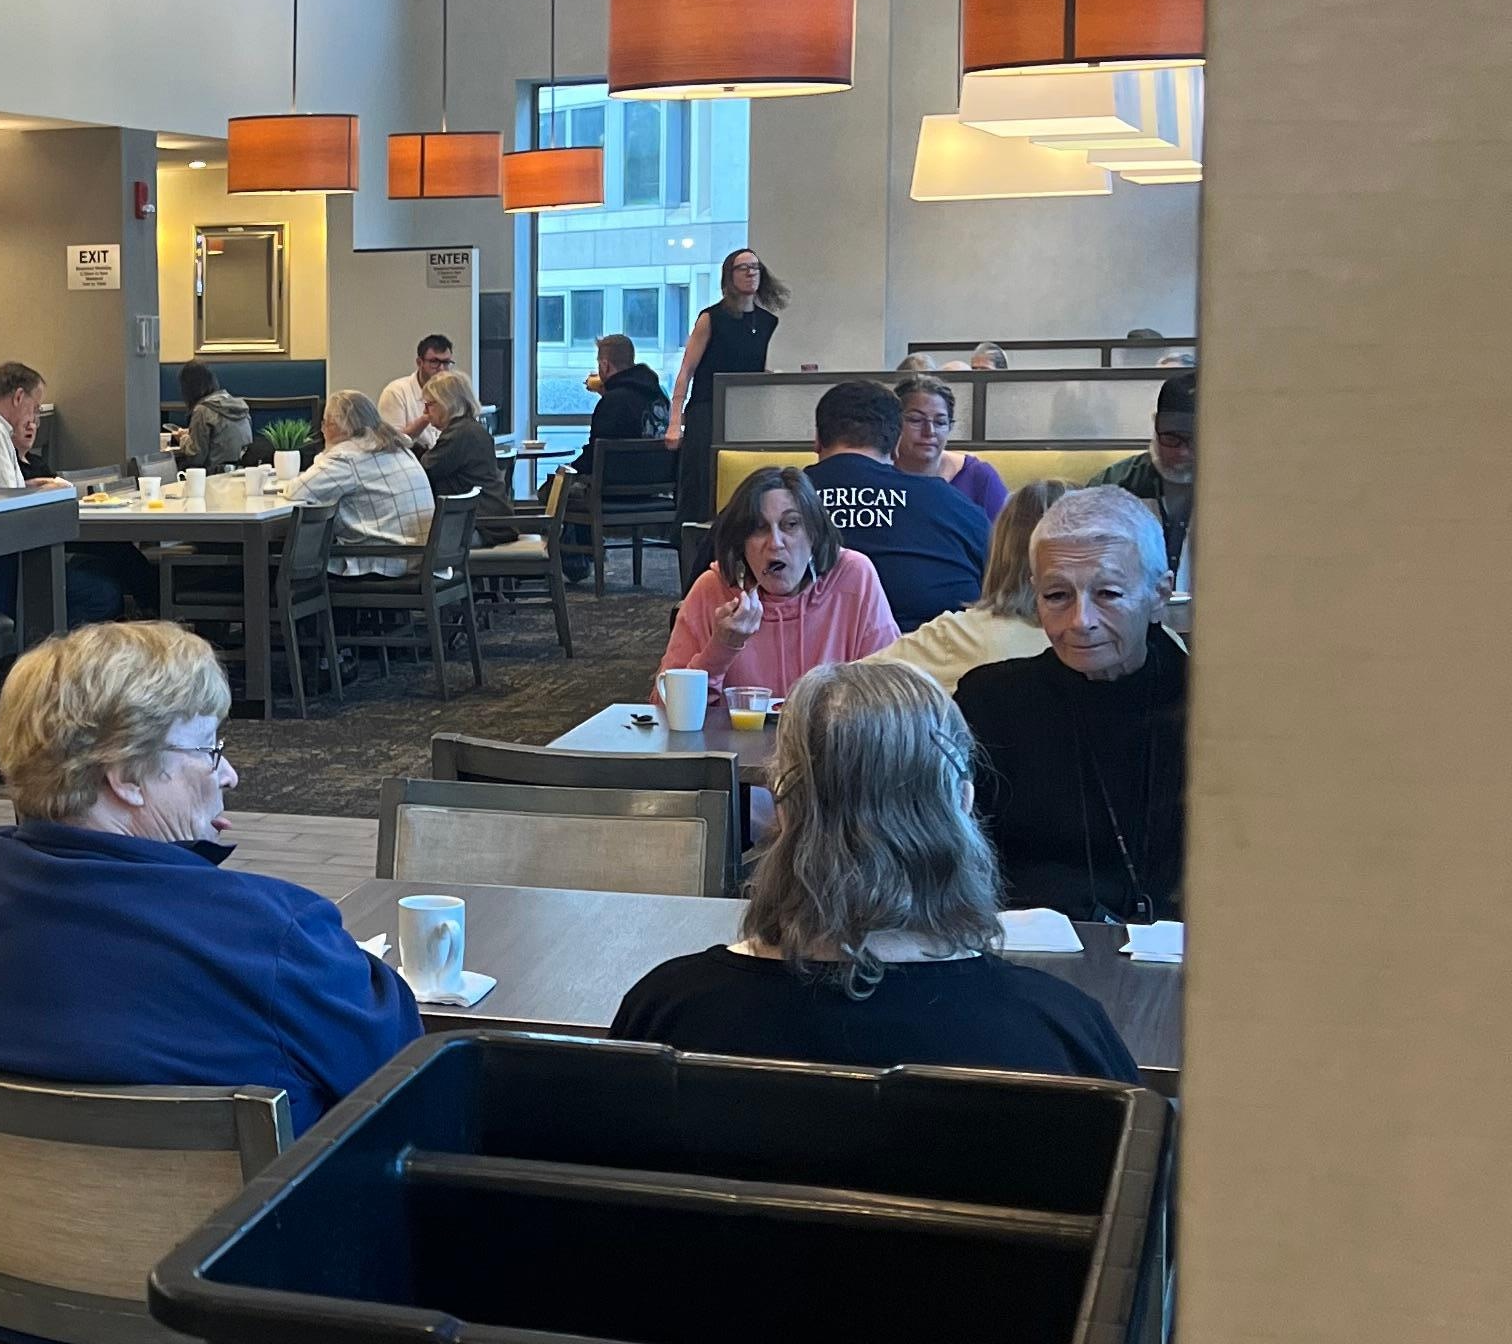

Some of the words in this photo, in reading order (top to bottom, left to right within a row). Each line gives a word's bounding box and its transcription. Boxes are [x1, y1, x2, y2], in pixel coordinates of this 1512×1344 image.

[79, 250, 109, 264] EXIT
[429, 253, 470, 265] ENTER
[817, 487, 907, 507] ERICAN
[828, 509, 894, 528] GION
